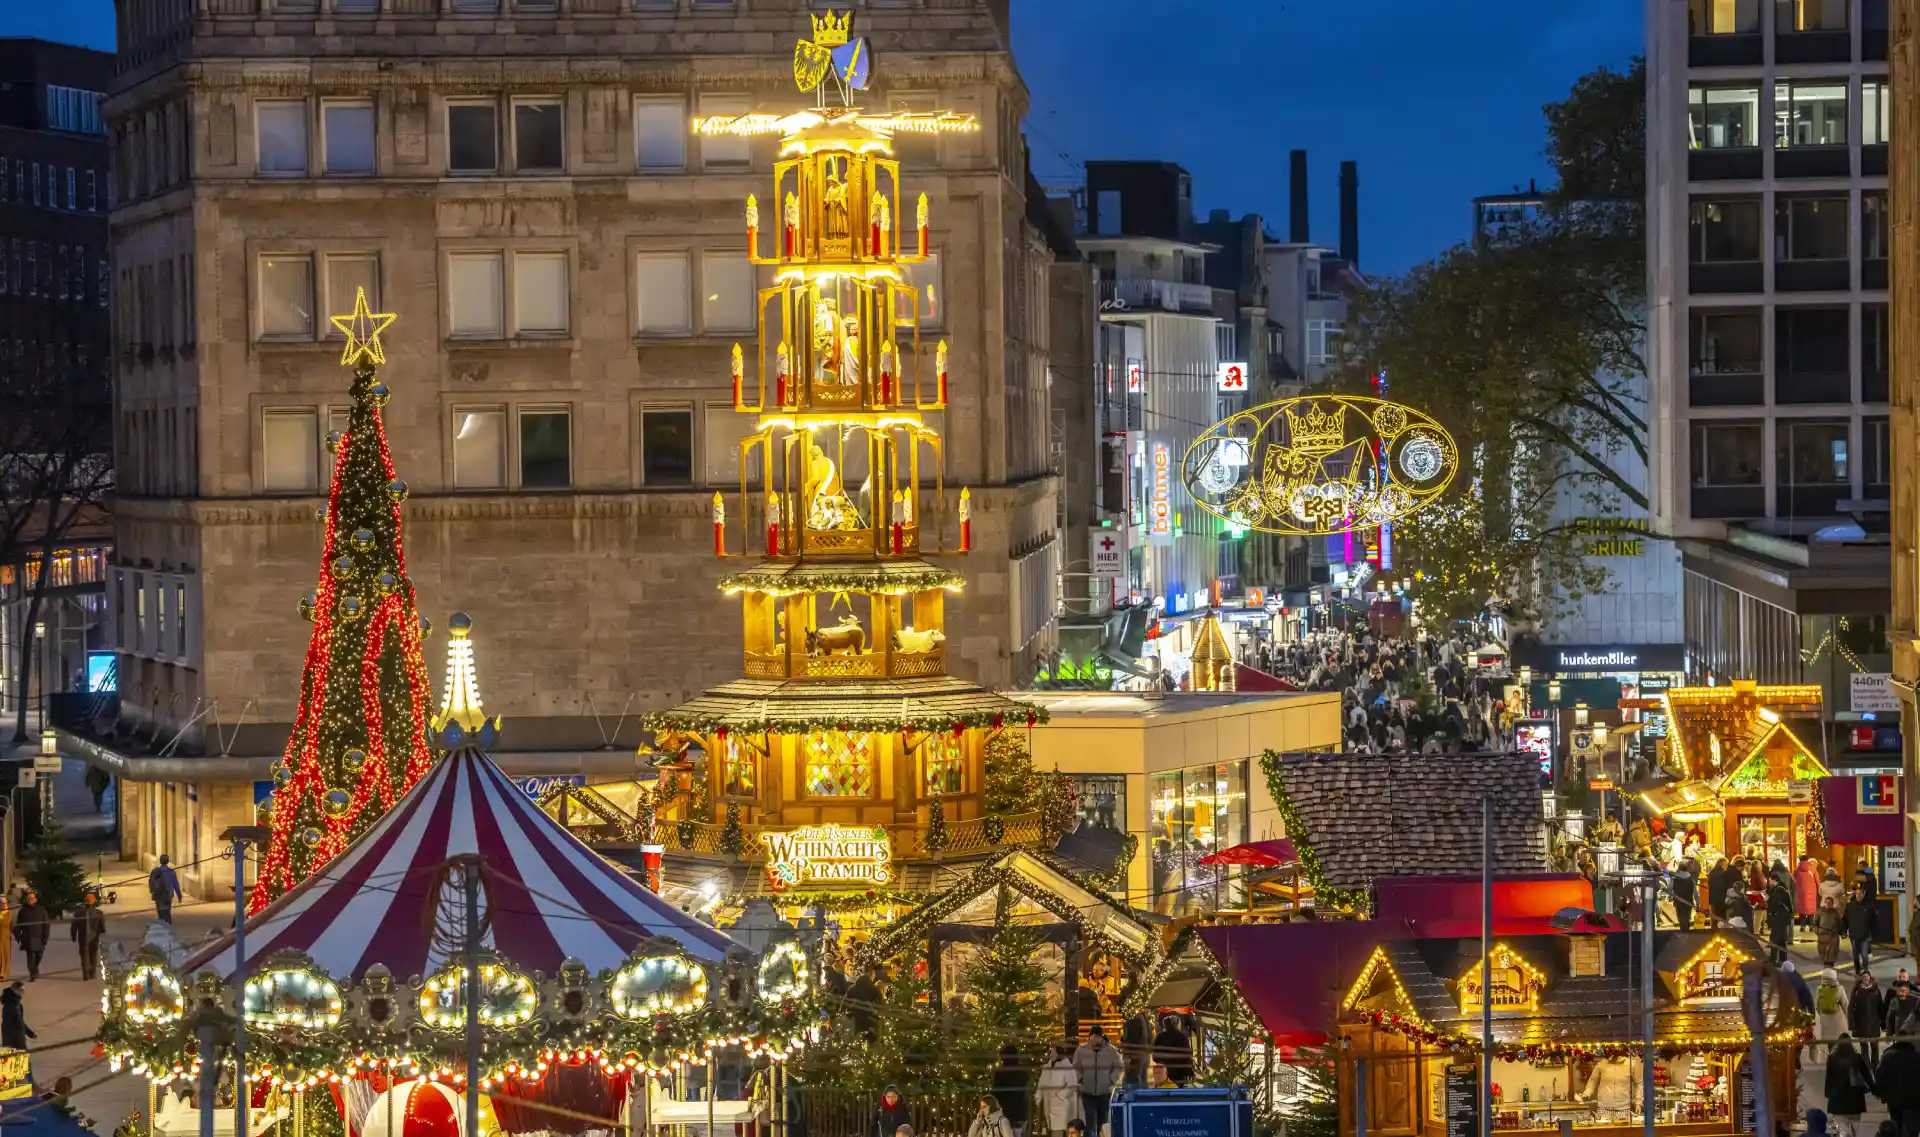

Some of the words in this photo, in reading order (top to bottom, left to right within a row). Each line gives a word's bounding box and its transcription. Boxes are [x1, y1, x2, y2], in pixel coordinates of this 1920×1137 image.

[1152, 443, 1169, 533] böhmer
[1586, 536, 1645, 556] GRÜNE
[1097, 552, 1119, 561] HIER
[1560, 652, 1638, 665] hunkemöller
[801, 827, 822, 839] DIE
[823, 825, 871, 840] ESSENER
[762, 833, 889, 866] WEIHNACHTS
[790, 857, 888, 884] PYRAMIDE
[1888, 861, 1906, 869] FISC
